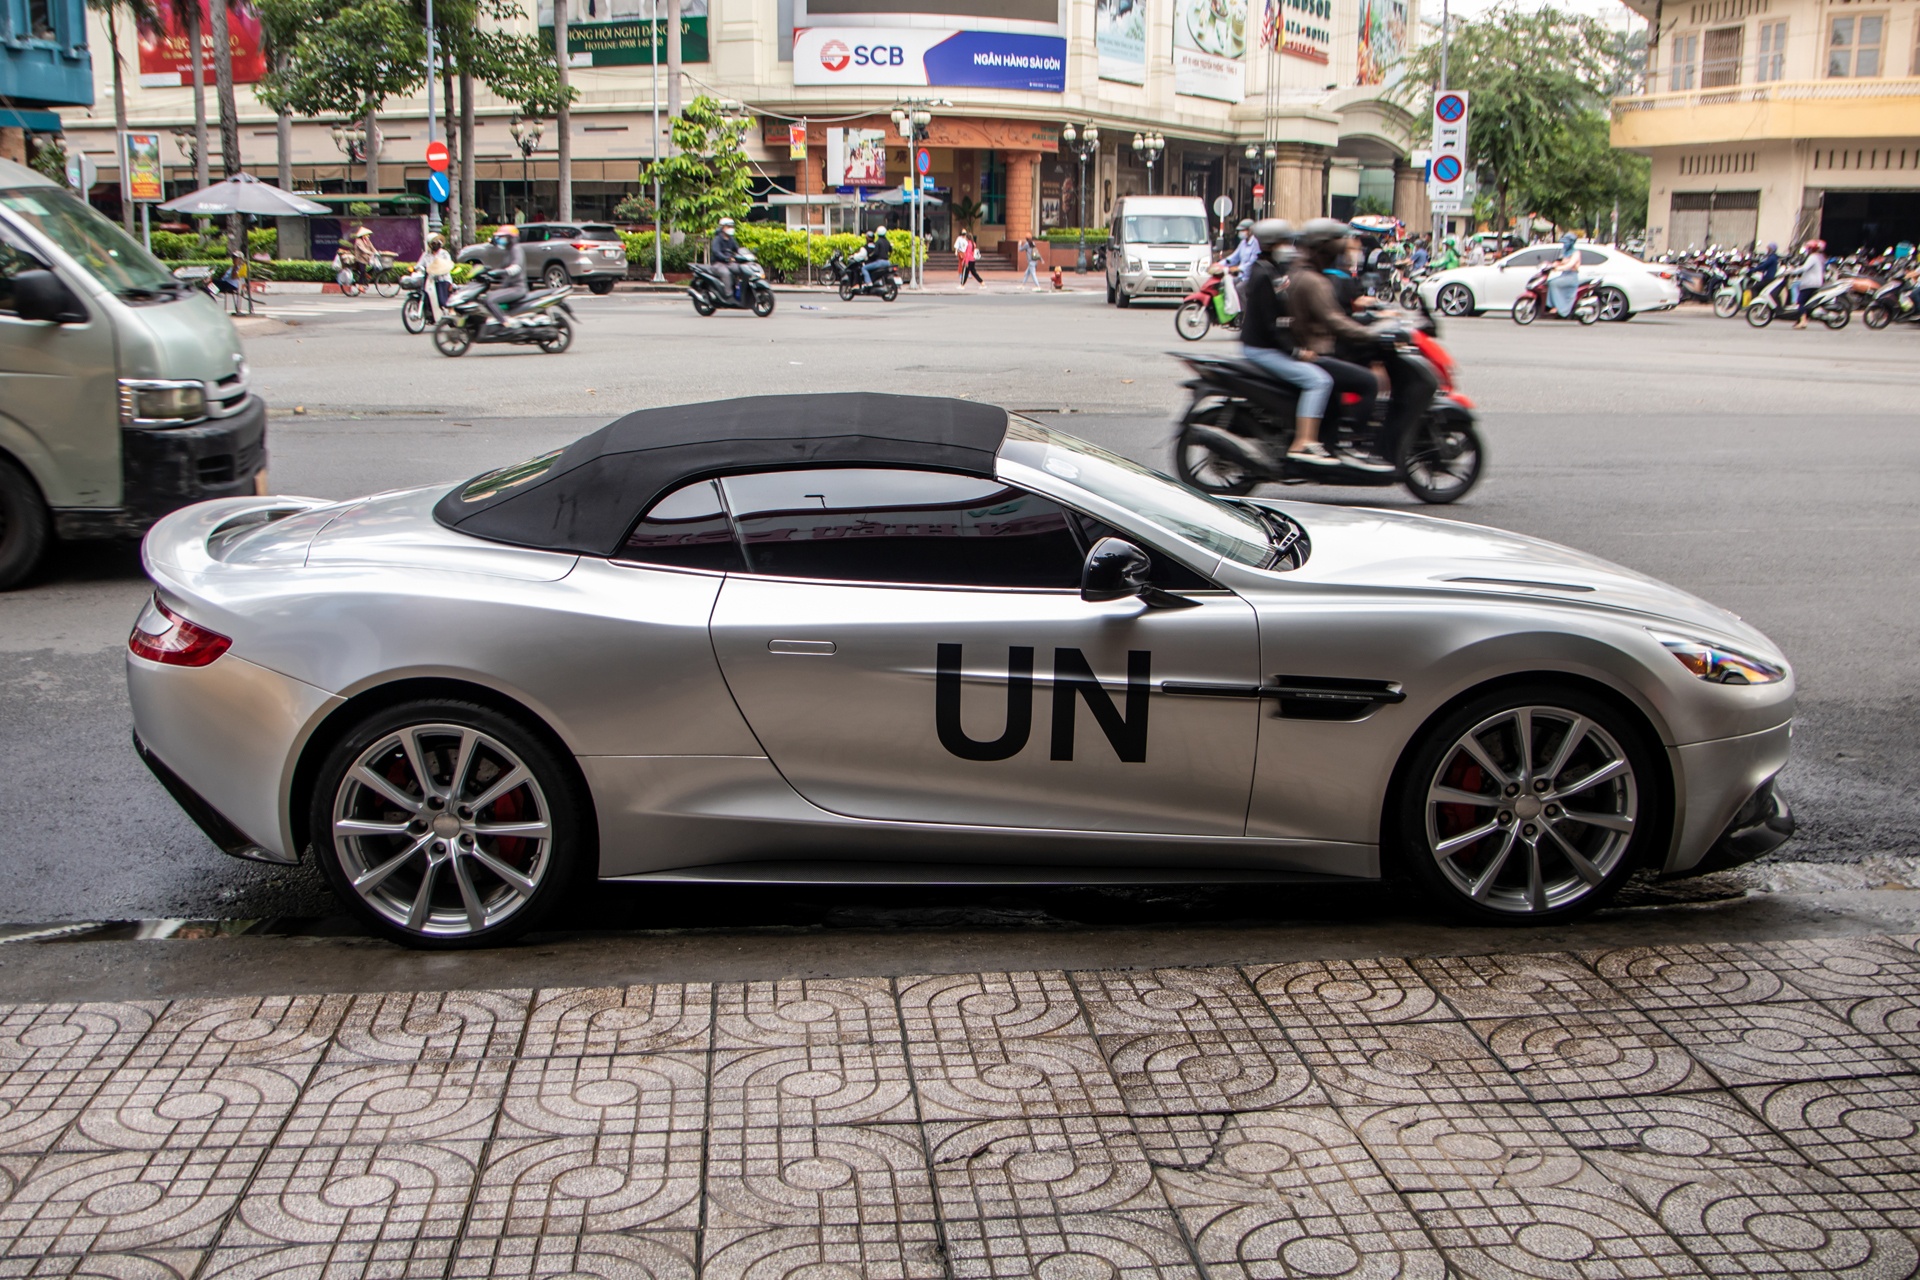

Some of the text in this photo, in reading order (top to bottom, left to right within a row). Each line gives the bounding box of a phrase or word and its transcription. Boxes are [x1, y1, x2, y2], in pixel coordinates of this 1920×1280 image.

[854, 45, 904, 66] SCB
[973, 51, 1061, 71] NGÂN HÀNG SÀI GÒN
[936, 643, 1151, 763] UN
